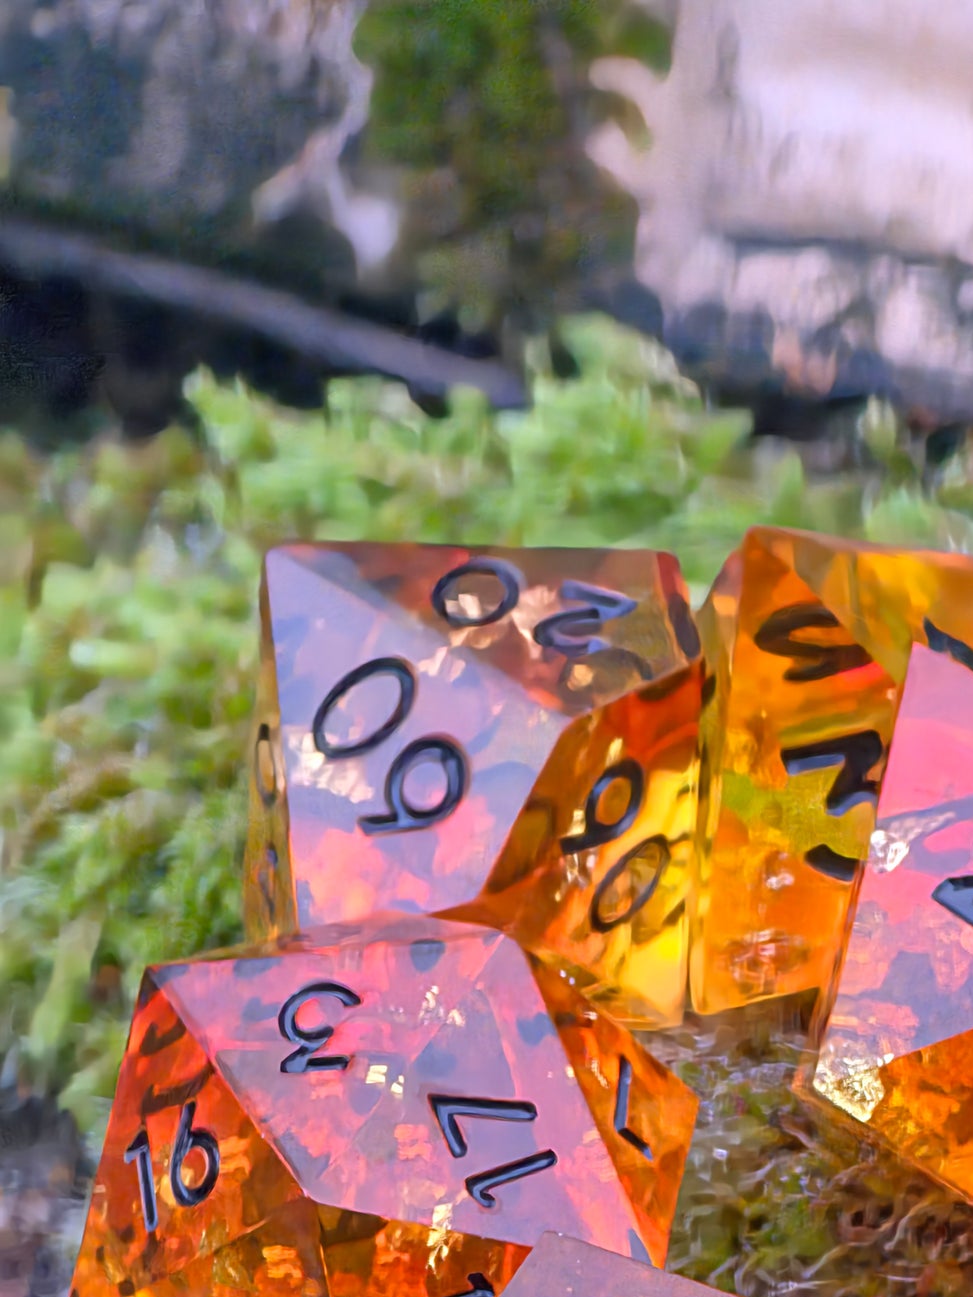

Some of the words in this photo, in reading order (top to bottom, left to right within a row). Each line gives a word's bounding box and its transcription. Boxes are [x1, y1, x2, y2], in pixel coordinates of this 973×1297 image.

[278, 981, 362, 1074] 3
[125, 1101, 221, 1232] 16
[428, 1093, 557, 1209] 17
